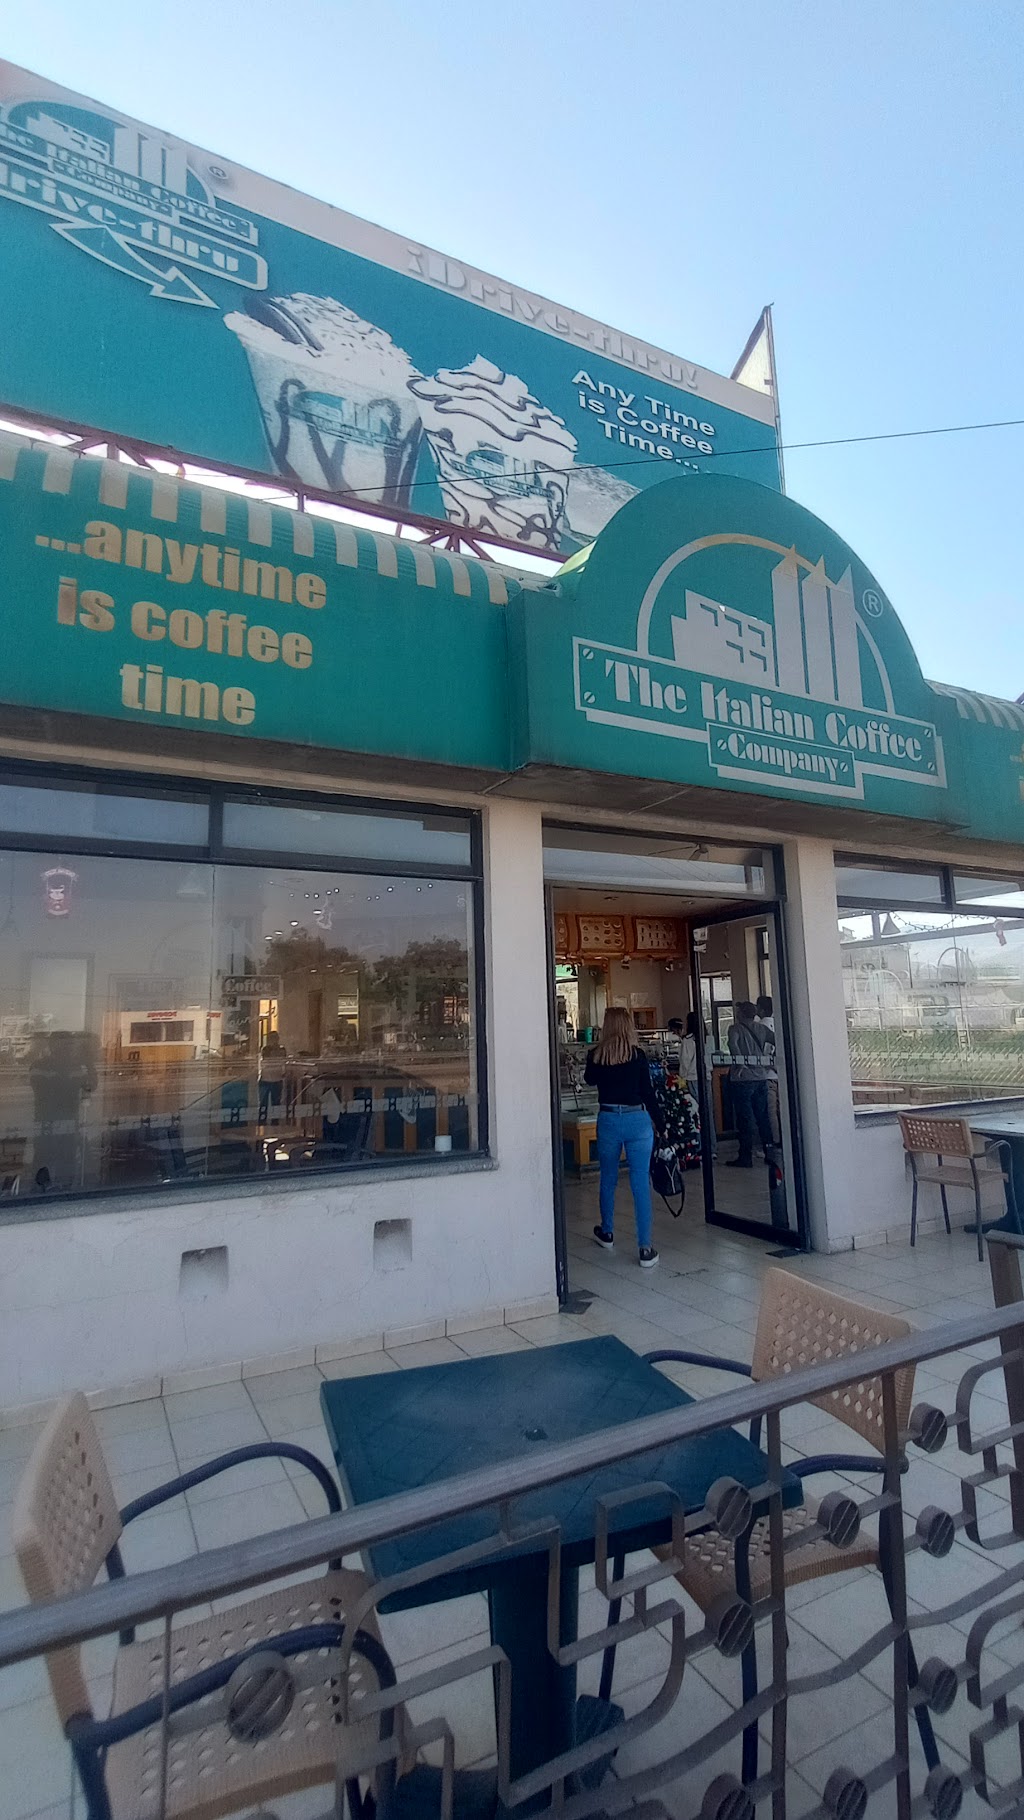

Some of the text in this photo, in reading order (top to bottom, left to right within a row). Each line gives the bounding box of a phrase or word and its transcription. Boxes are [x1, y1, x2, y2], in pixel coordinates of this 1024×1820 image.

[47, 142, 140, 192] Italian
[151, 187, 237, 230] Coffee
[571, 369, 717, 436] Any Time
[578, 390, 714, 455] is Coffee
[597, 418, 700, 470] Time...
[35, 520, 327, 609] ...anytime
[57, 576, 313, 669] is coffee
[120, 663, 256, 725] time
[605, 659, 923, 762] The Italian Coffee
[727, 733, 840, 782] Company
